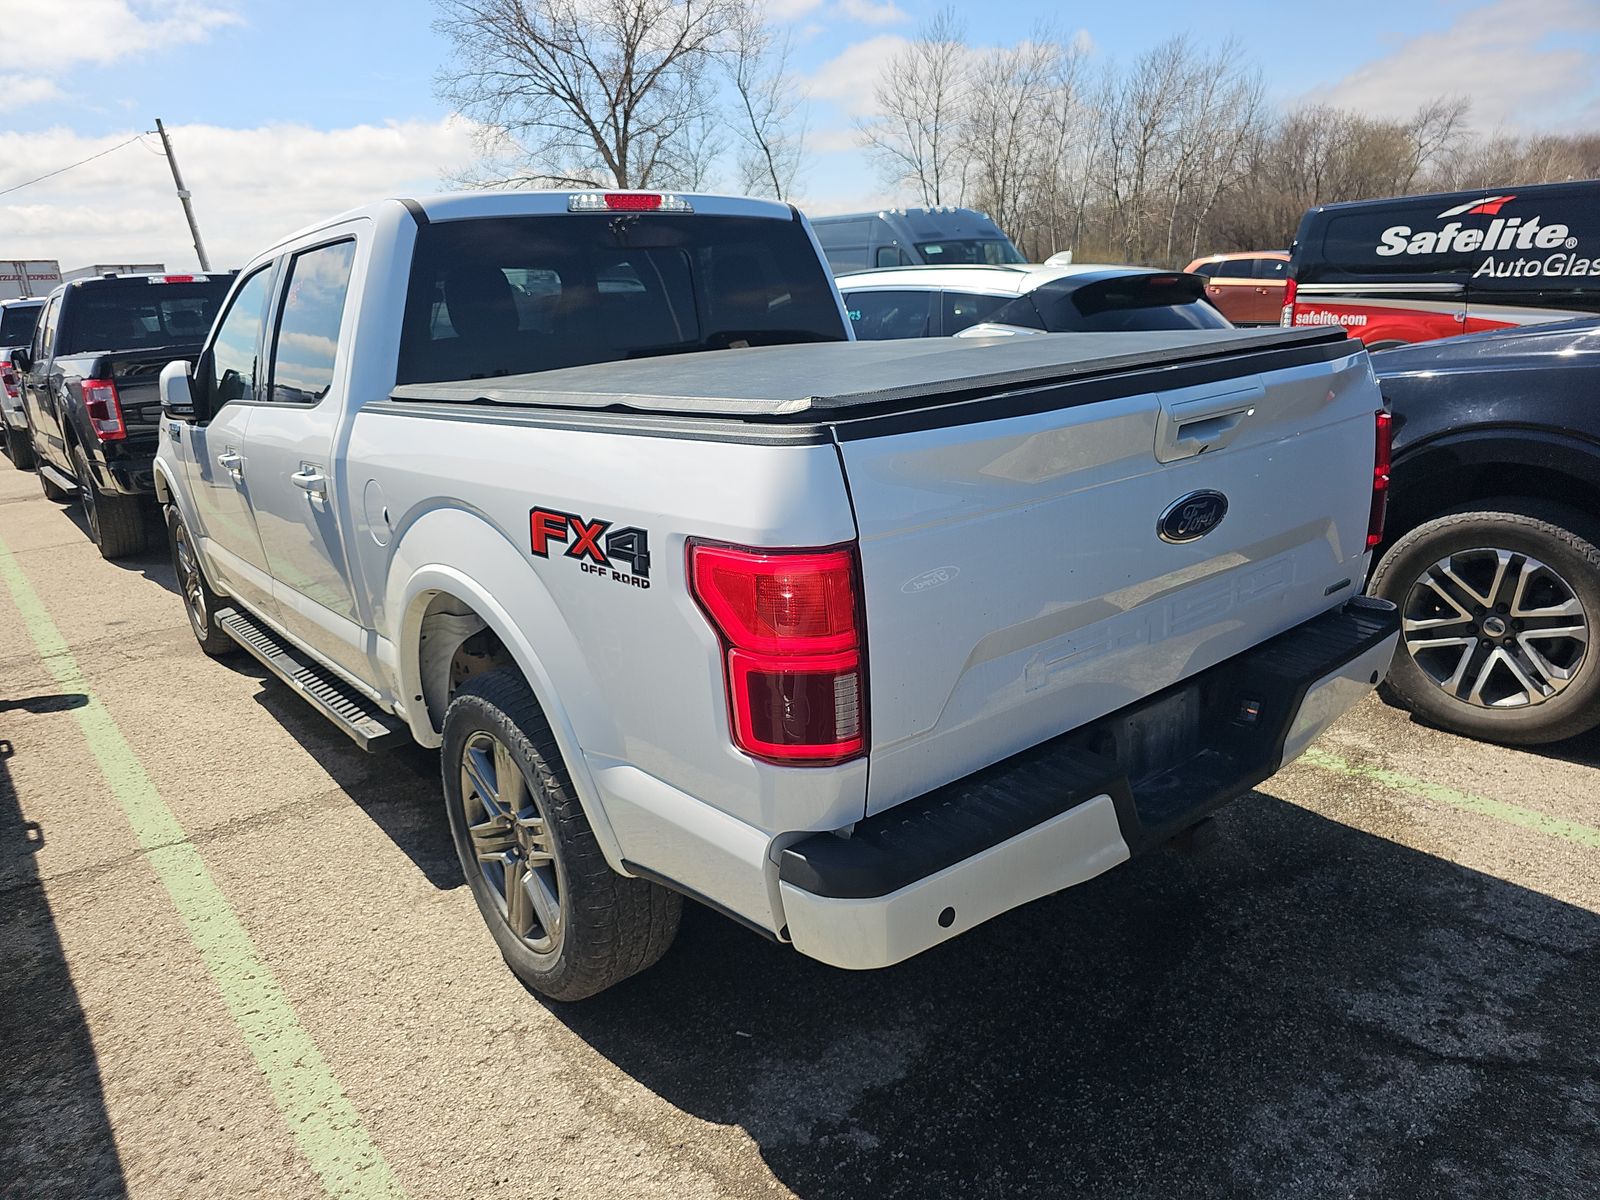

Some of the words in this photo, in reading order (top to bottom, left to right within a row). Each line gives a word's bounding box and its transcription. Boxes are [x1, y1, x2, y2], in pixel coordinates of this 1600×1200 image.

[27, 273, 58, 281] EXPRESS
[1295, 310, 1368, 326] safelite.com
[529, 505, 651, 579] FX4
[580, 562, 607, 577] OFF
[611, 570, 651, 589] ROAD
